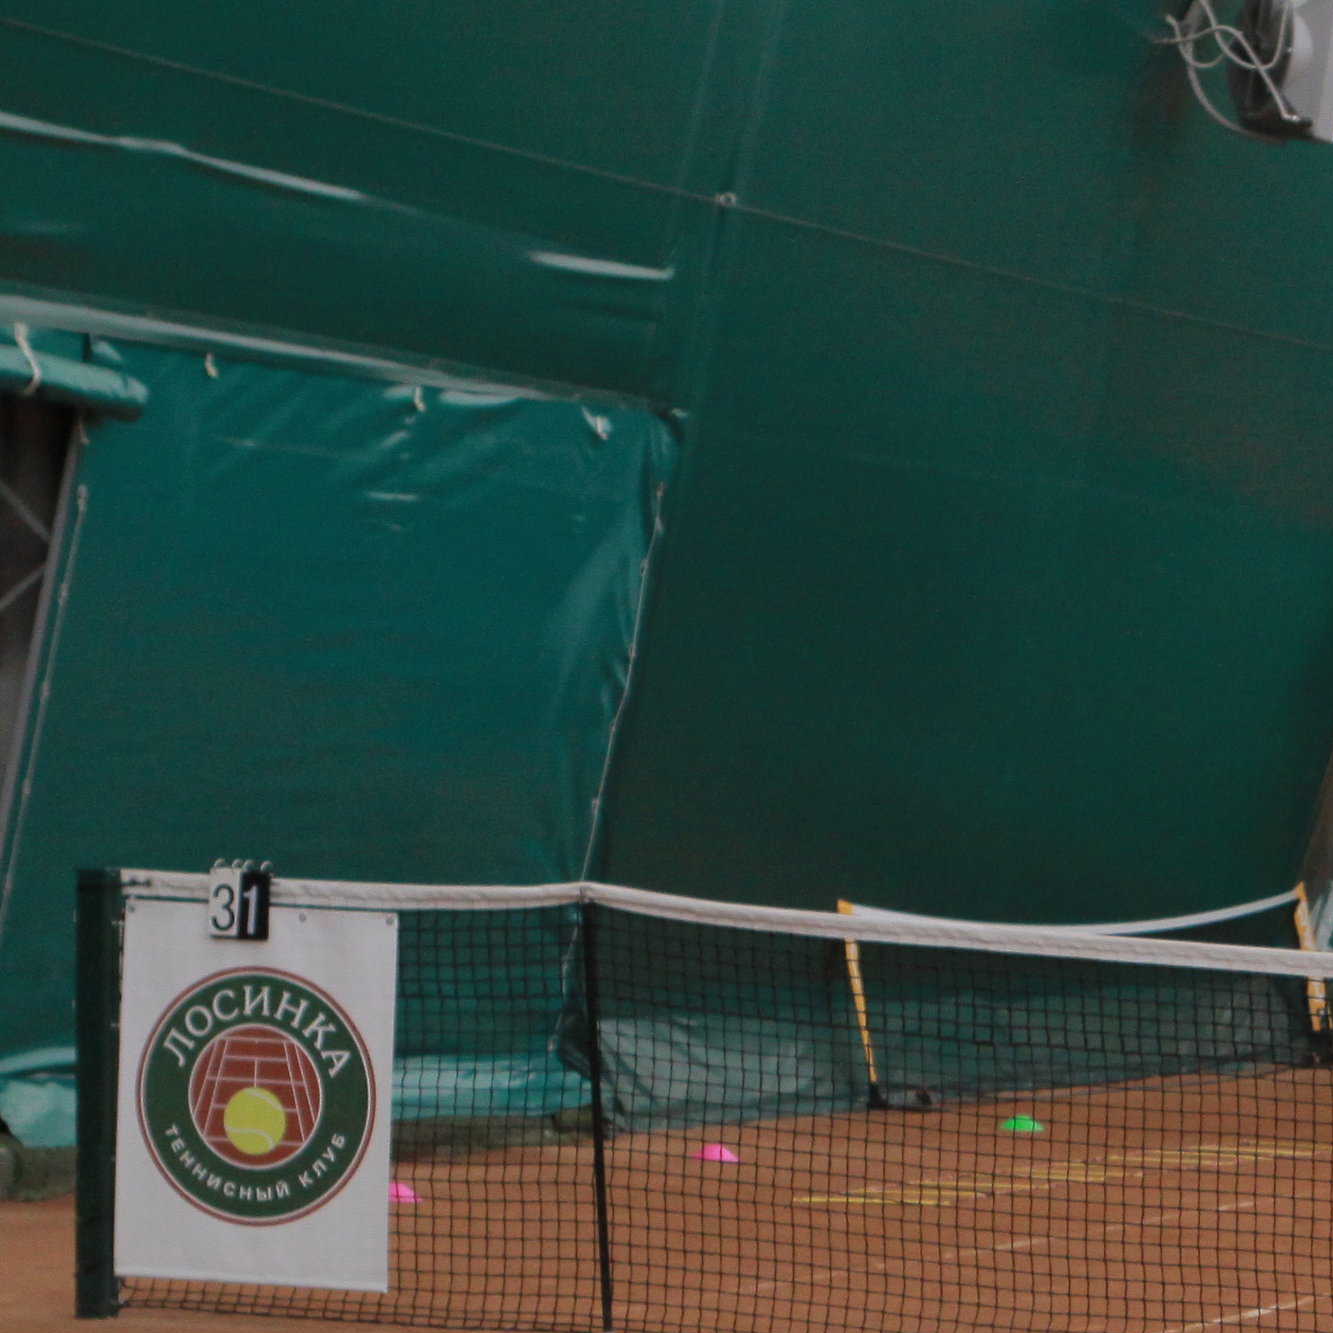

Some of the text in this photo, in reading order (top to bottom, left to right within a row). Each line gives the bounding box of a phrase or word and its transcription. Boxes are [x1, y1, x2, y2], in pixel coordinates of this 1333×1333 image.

[163, 985, 351, 1078] ЛОСИНКА
[165, 1124, 346, 1202] ТЕННИСНЫЙ КЛУБ
